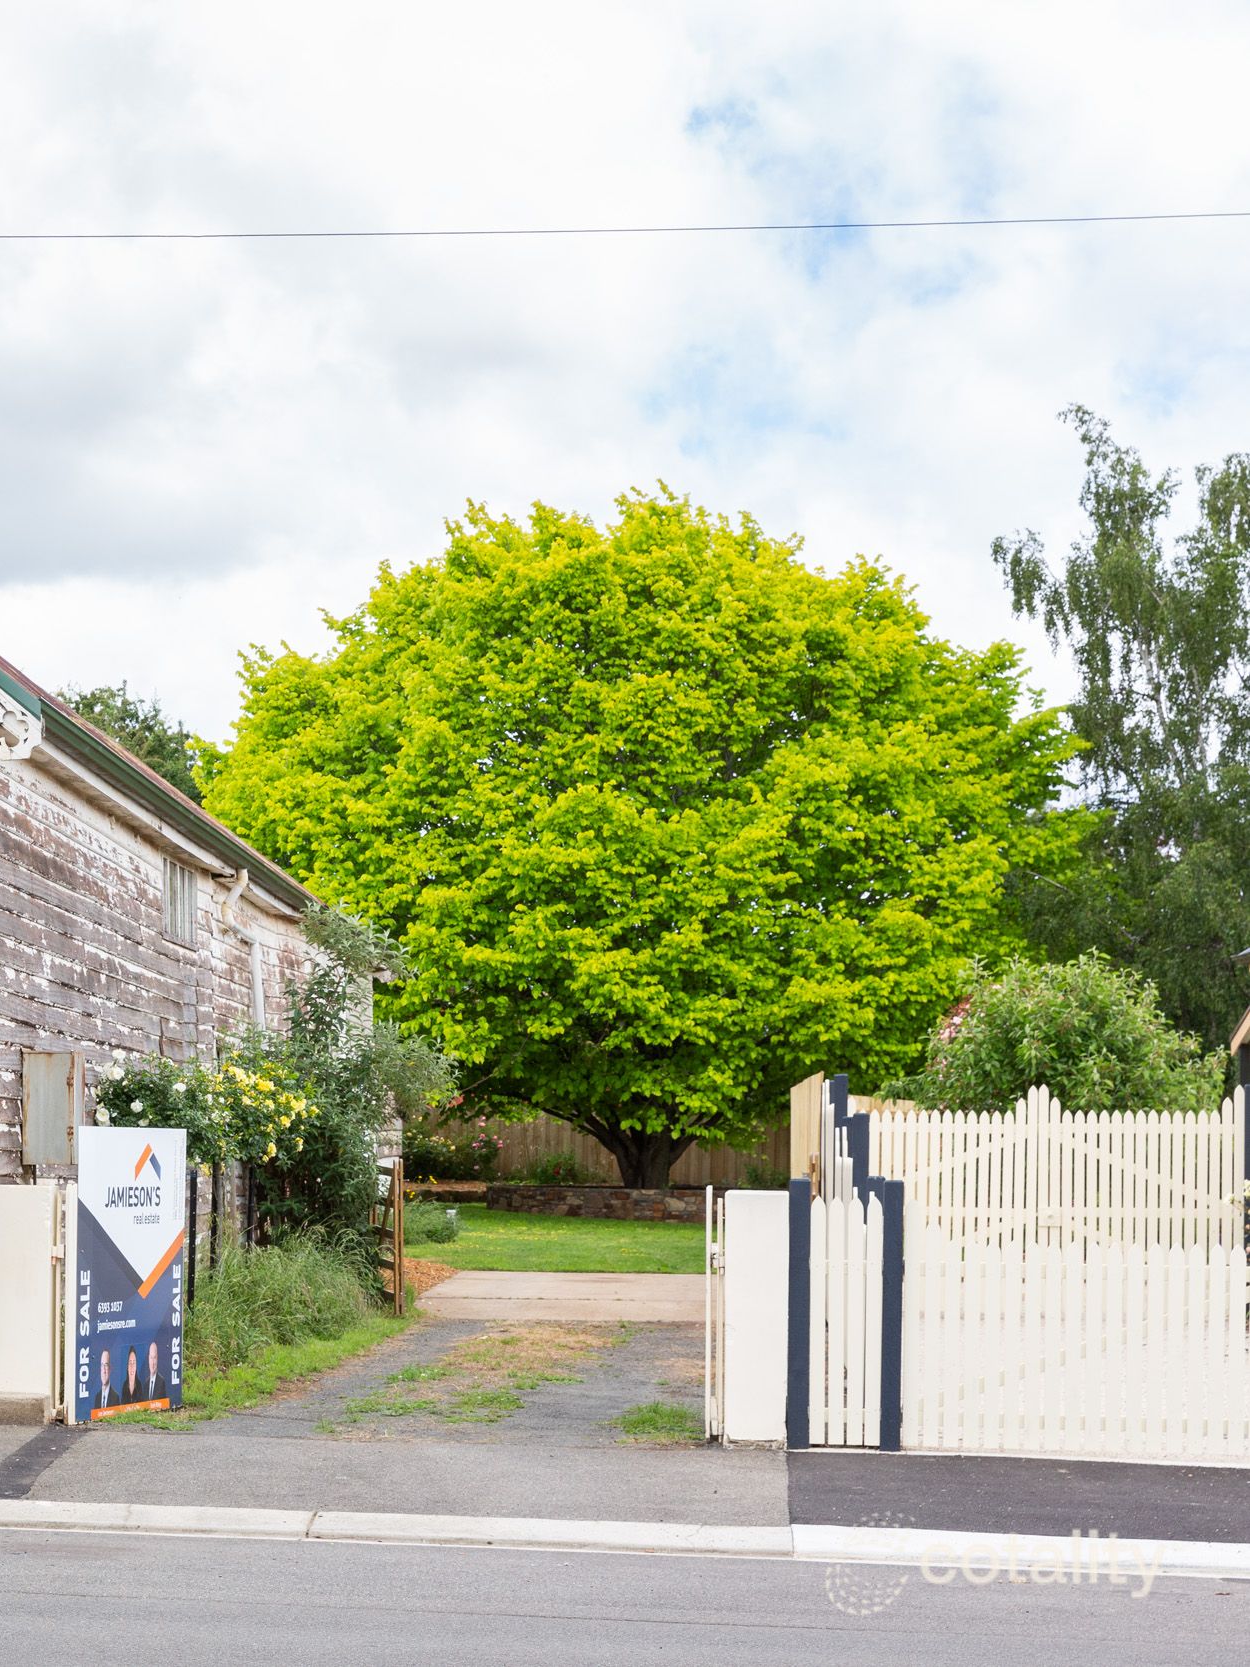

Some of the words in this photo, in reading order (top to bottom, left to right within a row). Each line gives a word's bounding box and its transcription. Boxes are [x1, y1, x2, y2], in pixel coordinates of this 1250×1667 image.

[104, 1186, 161, 1208] JAMIESON'S
[80, 1270, 91, 1337] SALE
[172, 1264, 182, 1327] SALE
[79, 1346, 90, 1399] FOR
[171, 1336, 181, 1385] FOR
